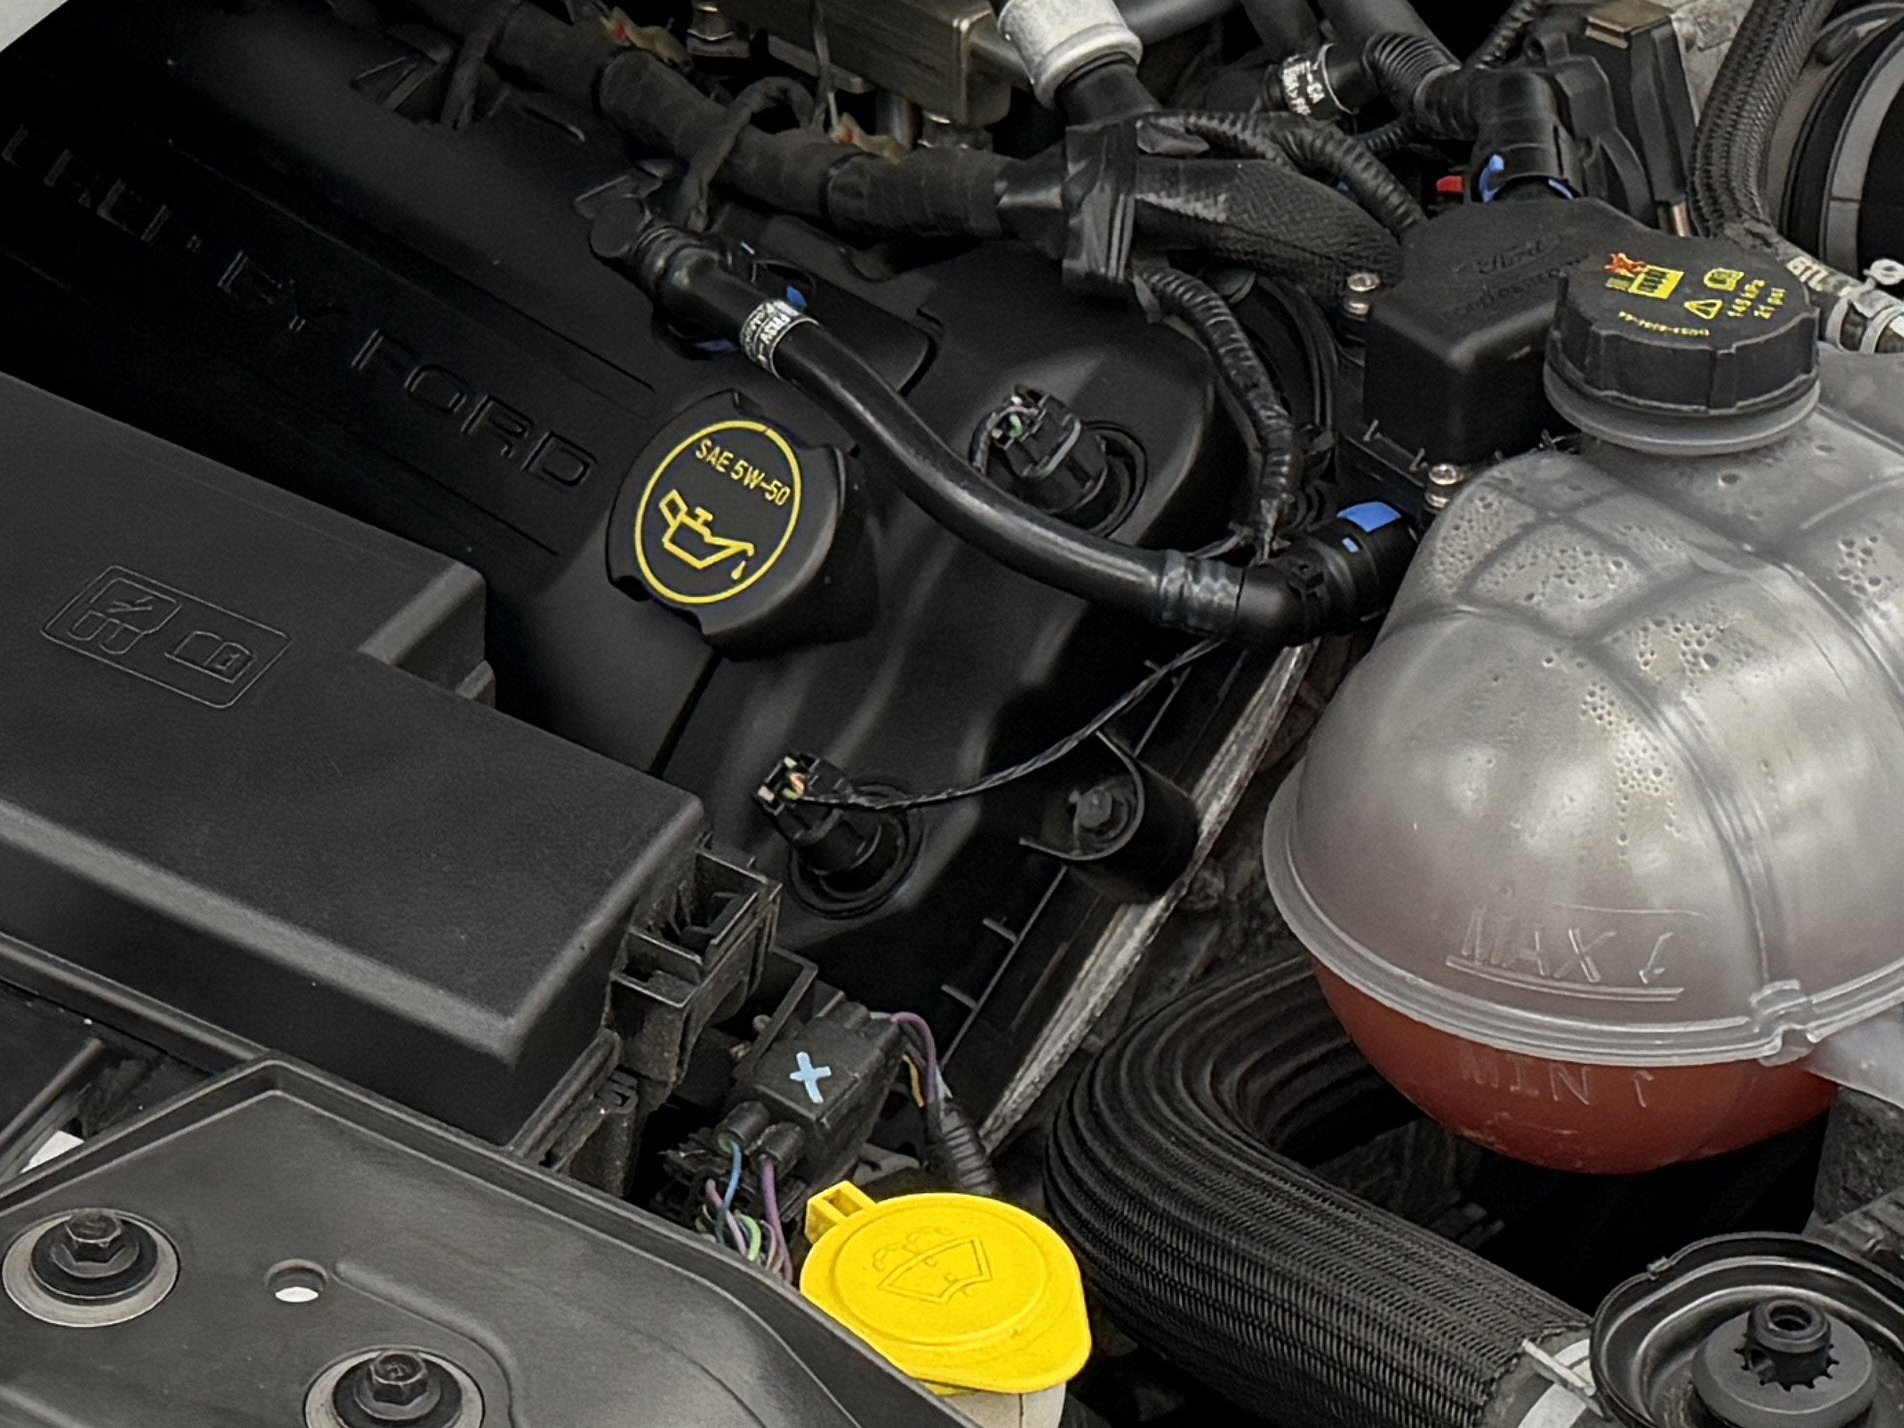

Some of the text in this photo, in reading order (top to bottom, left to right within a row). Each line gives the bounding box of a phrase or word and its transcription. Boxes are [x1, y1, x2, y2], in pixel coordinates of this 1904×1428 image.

[350, 327, 597, 489] FORD
[696, 438, 791, 506] SAE 5W-50
[1460, 904, 1617, 984] MAX
